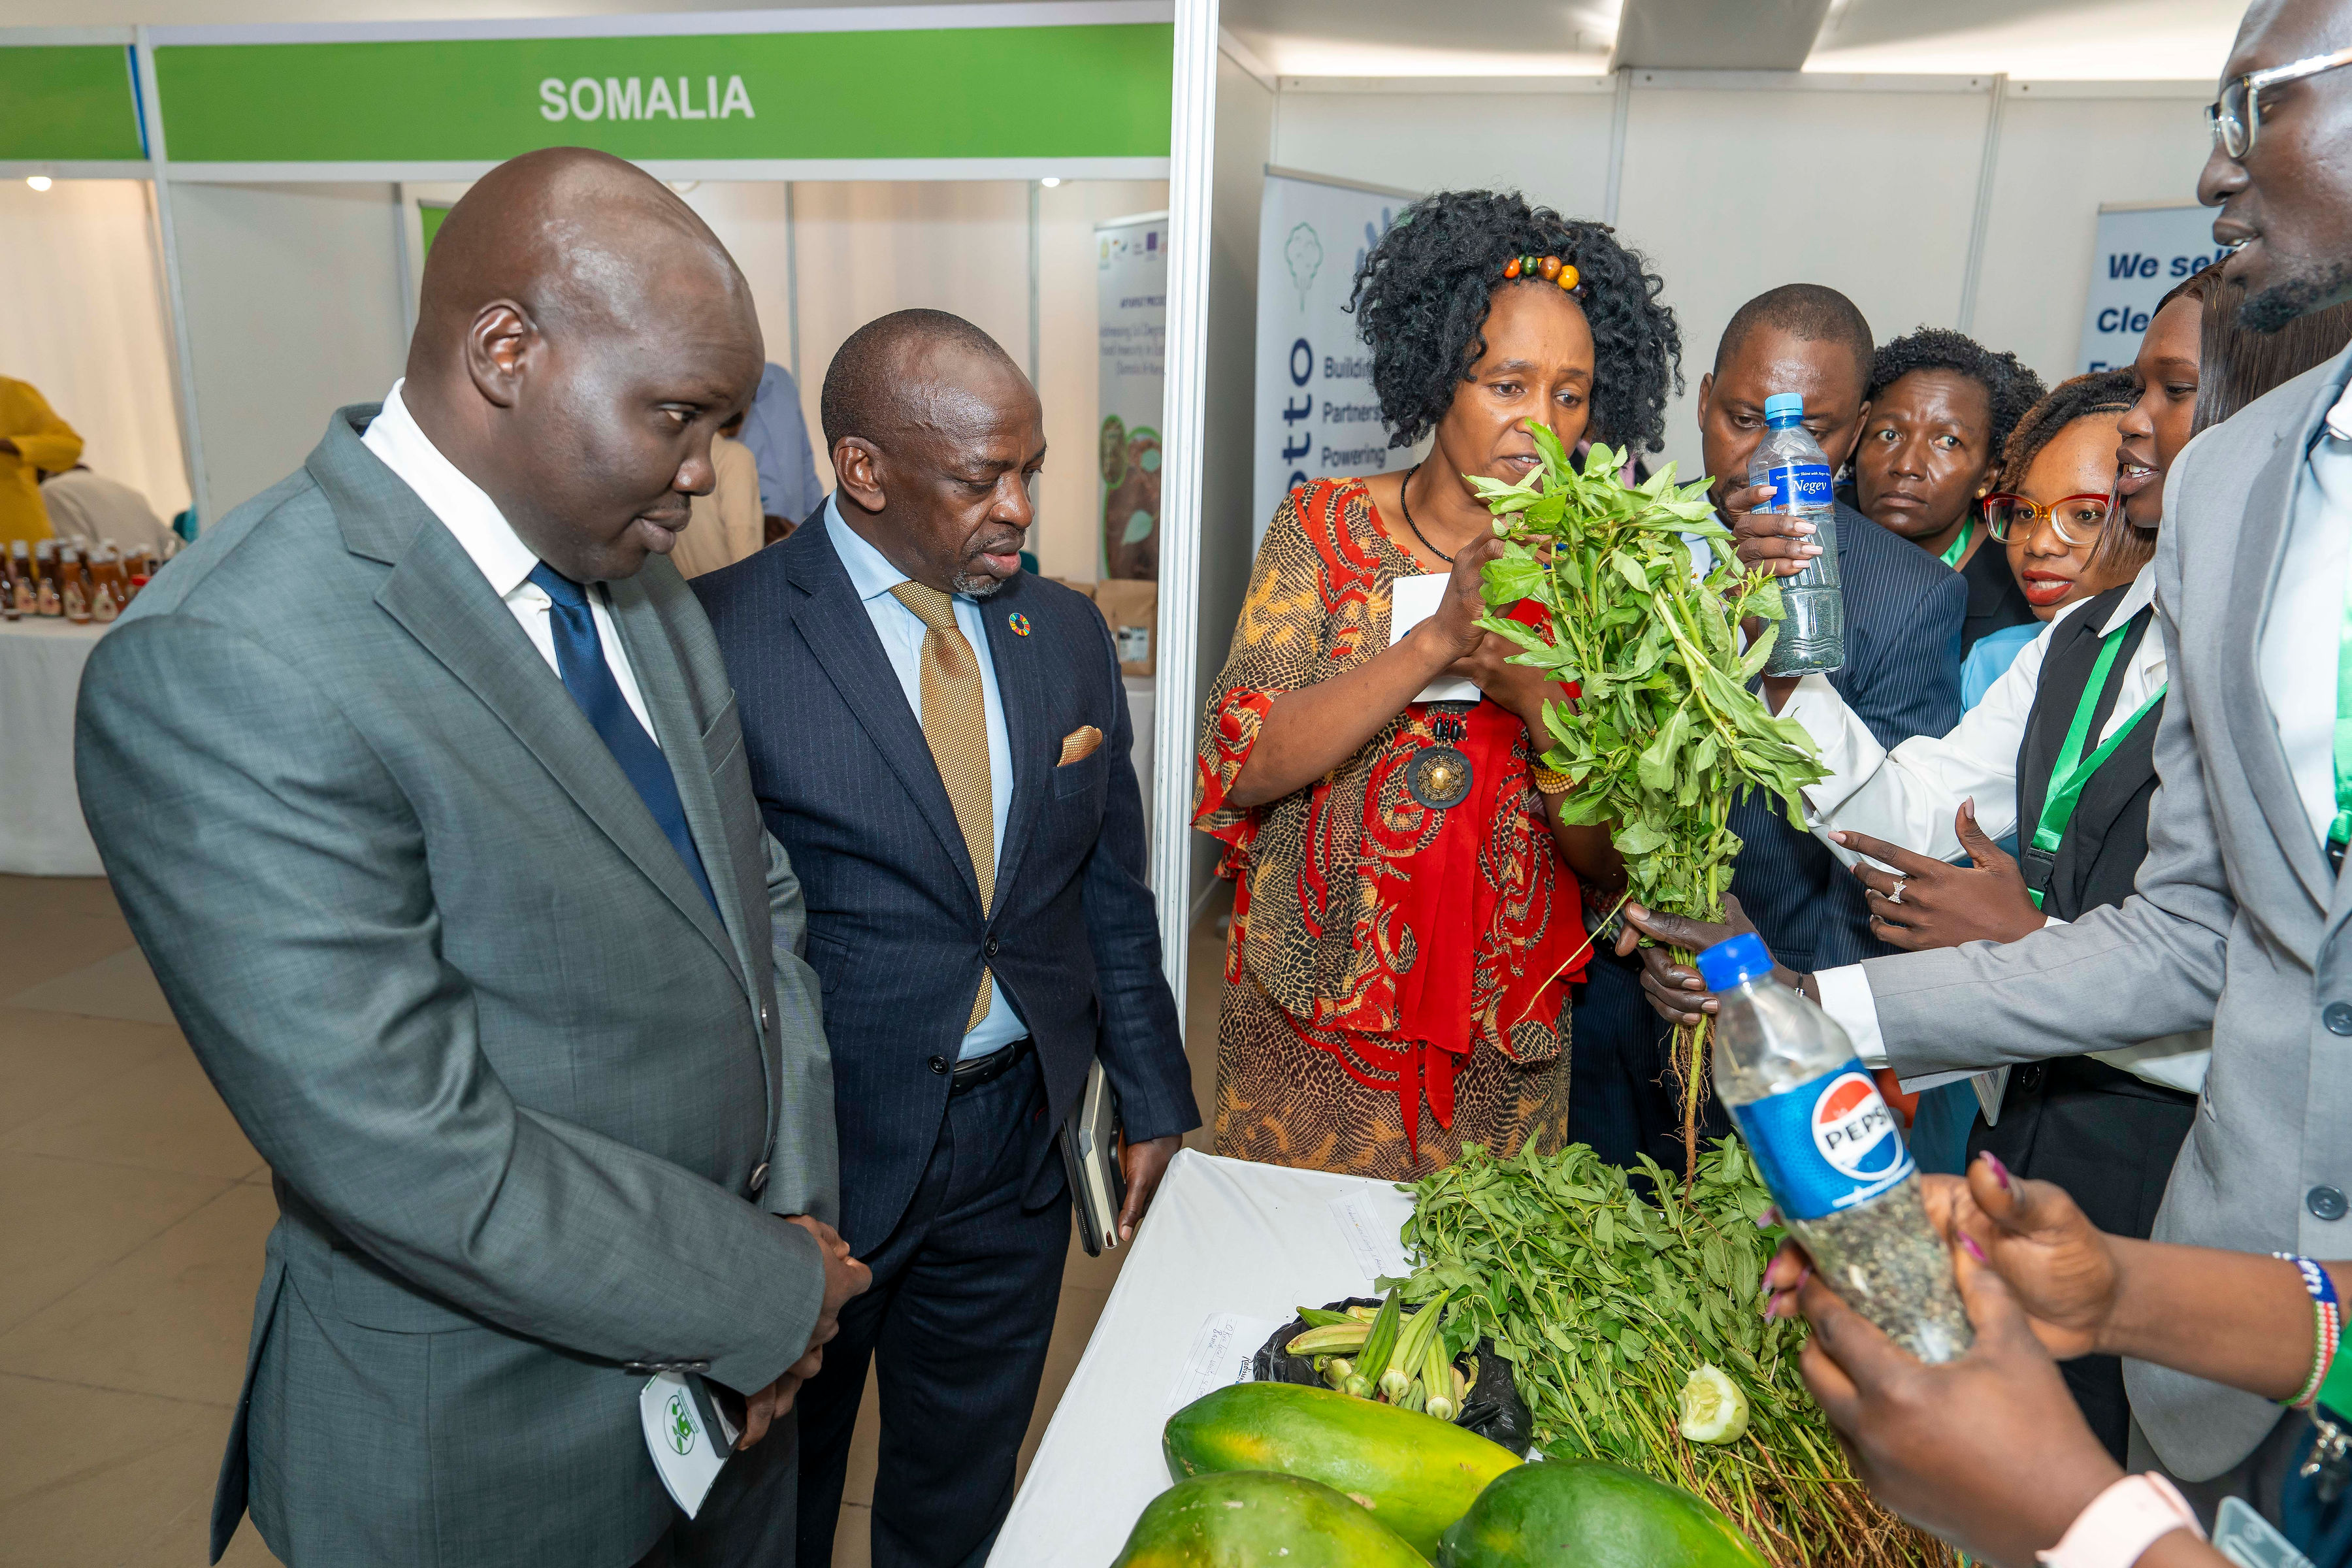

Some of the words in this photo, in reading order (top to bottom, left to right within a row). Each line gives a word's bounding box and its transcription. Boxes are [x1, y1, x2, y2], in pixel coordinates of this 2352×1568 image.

[539, 75, 755, 122] SOMALIA
[2108, 252, 2159, 279] We
[2170, 248, 2234, 276] sel
[2097, 306, 2150, 333] Cle
[1321, 446, 1386, 468] Powering
[1791, 480, 1827, 495] Negev
[1825, 1105, 1888, 1151] PEPS
